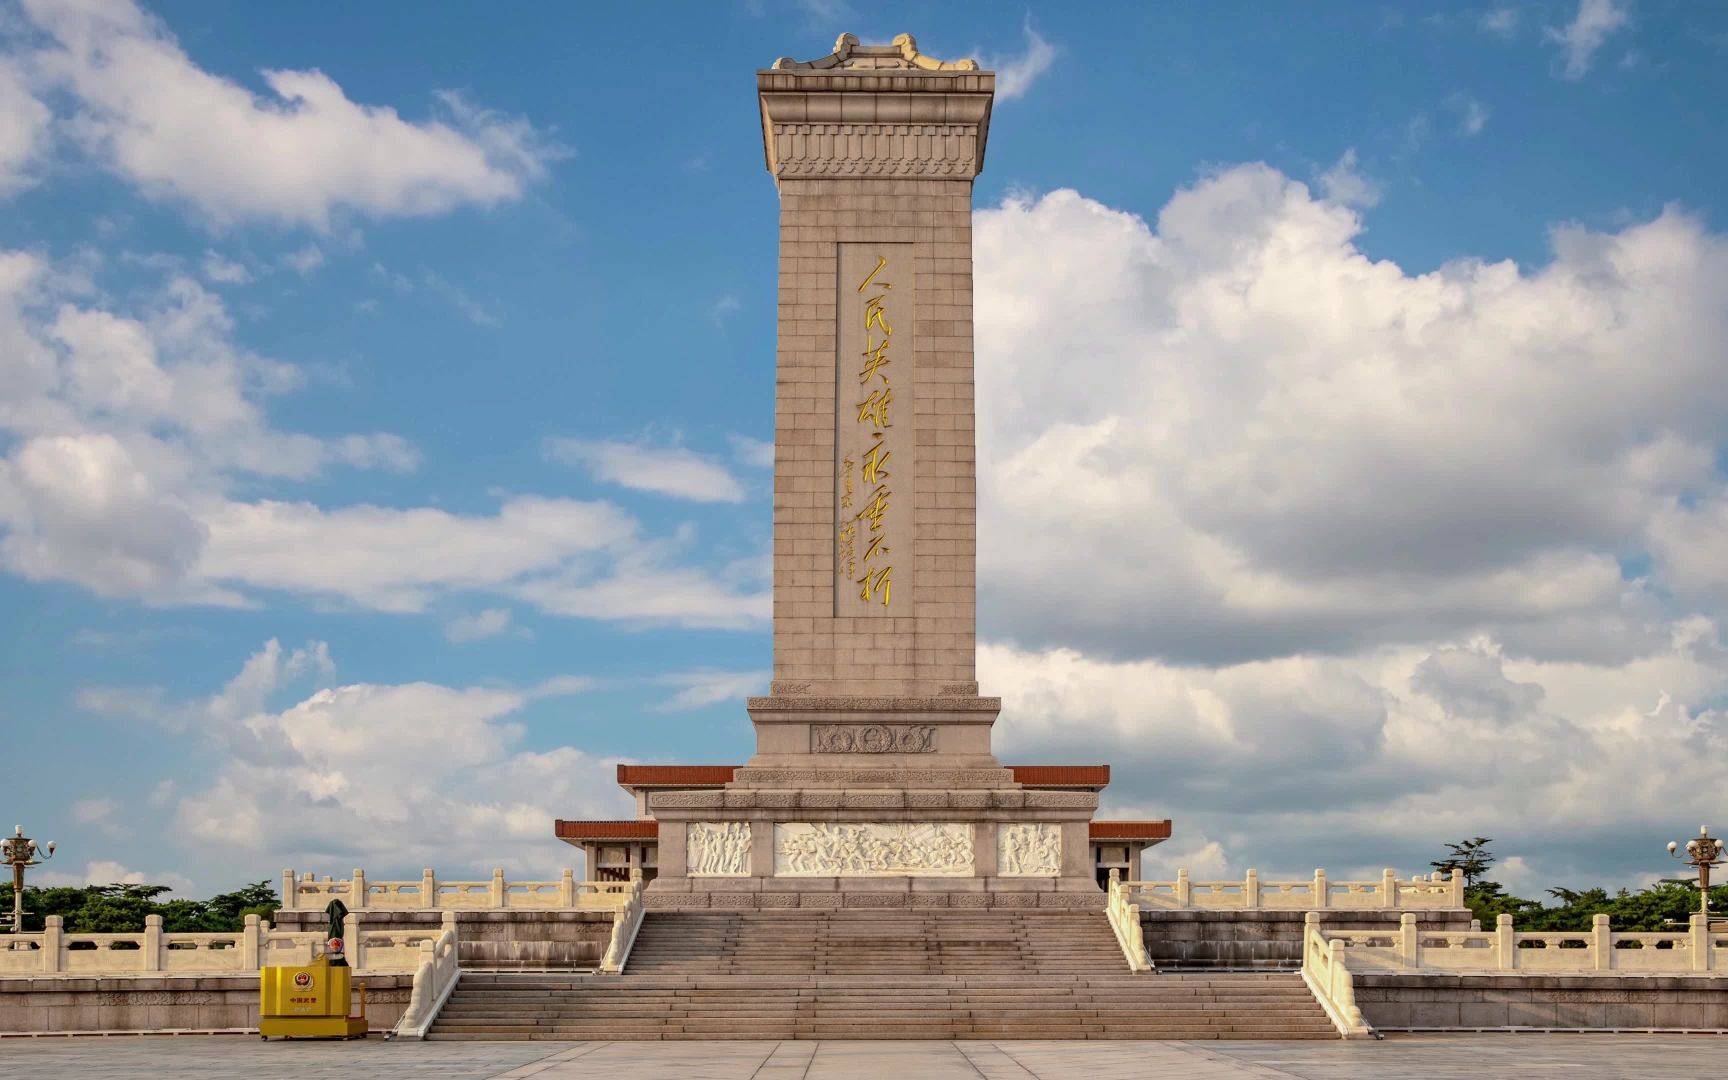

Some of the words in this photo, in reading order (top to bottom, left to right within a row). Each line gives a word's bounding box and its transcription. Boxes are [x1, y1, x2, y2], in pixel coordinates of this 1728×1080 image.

[856, 255, 893, 607] 人民英雄永垂不朽
